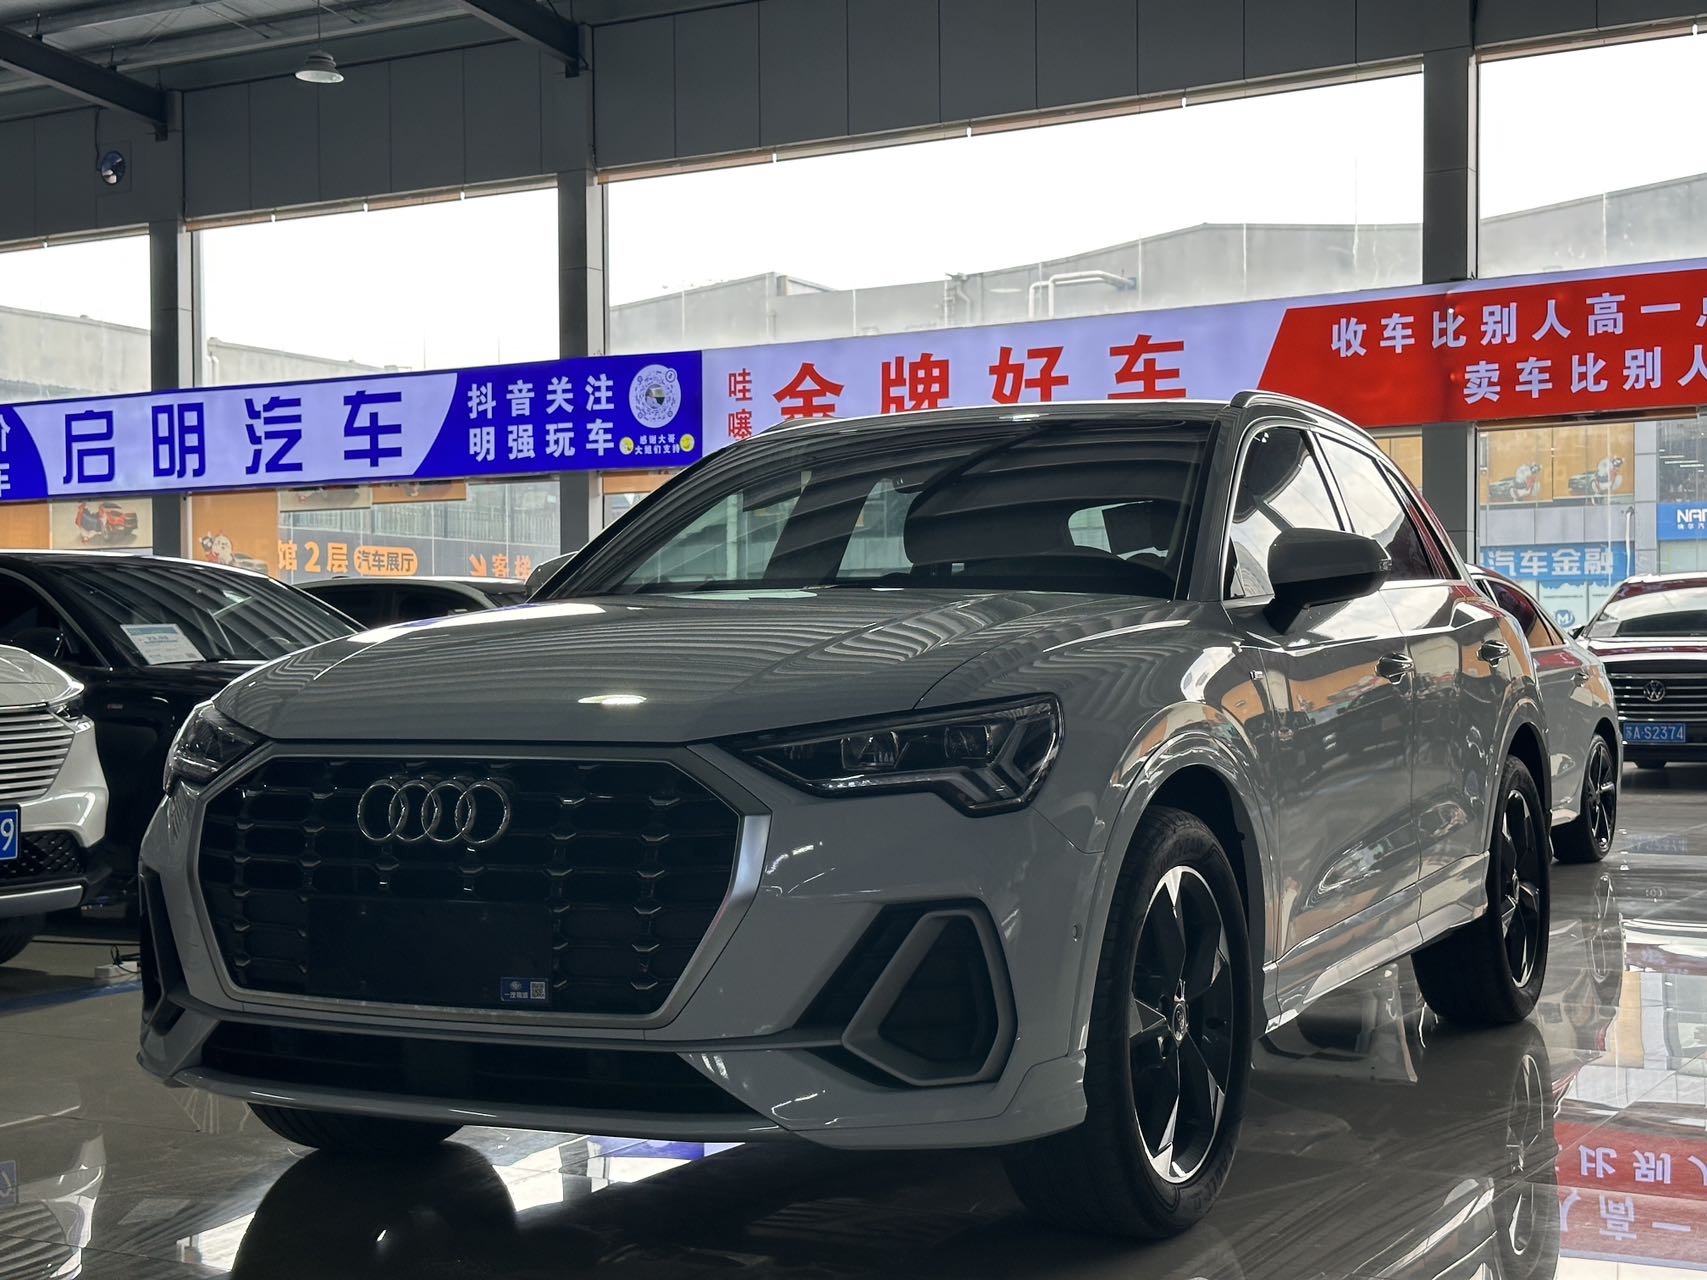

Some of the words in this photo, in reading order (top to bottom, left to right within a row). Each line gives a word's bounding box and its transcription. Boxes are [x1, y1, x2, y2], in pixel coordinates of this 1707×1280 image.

[1331, 292, 1707, 357] 收车比别人高一
[467, 373, 615, 420] 抖音关注
[773, 334, 1186, 420] 金牌好车
[1463, 345, 1707, 404] 卖车比别人
[63, 390, 402, 485] 启明汽车
[468, 418, 615, 462] 明强玩车
[358, 550, 414, 572] 汽车展厅
[1480, 548, 1614, 576] 汽车金融
